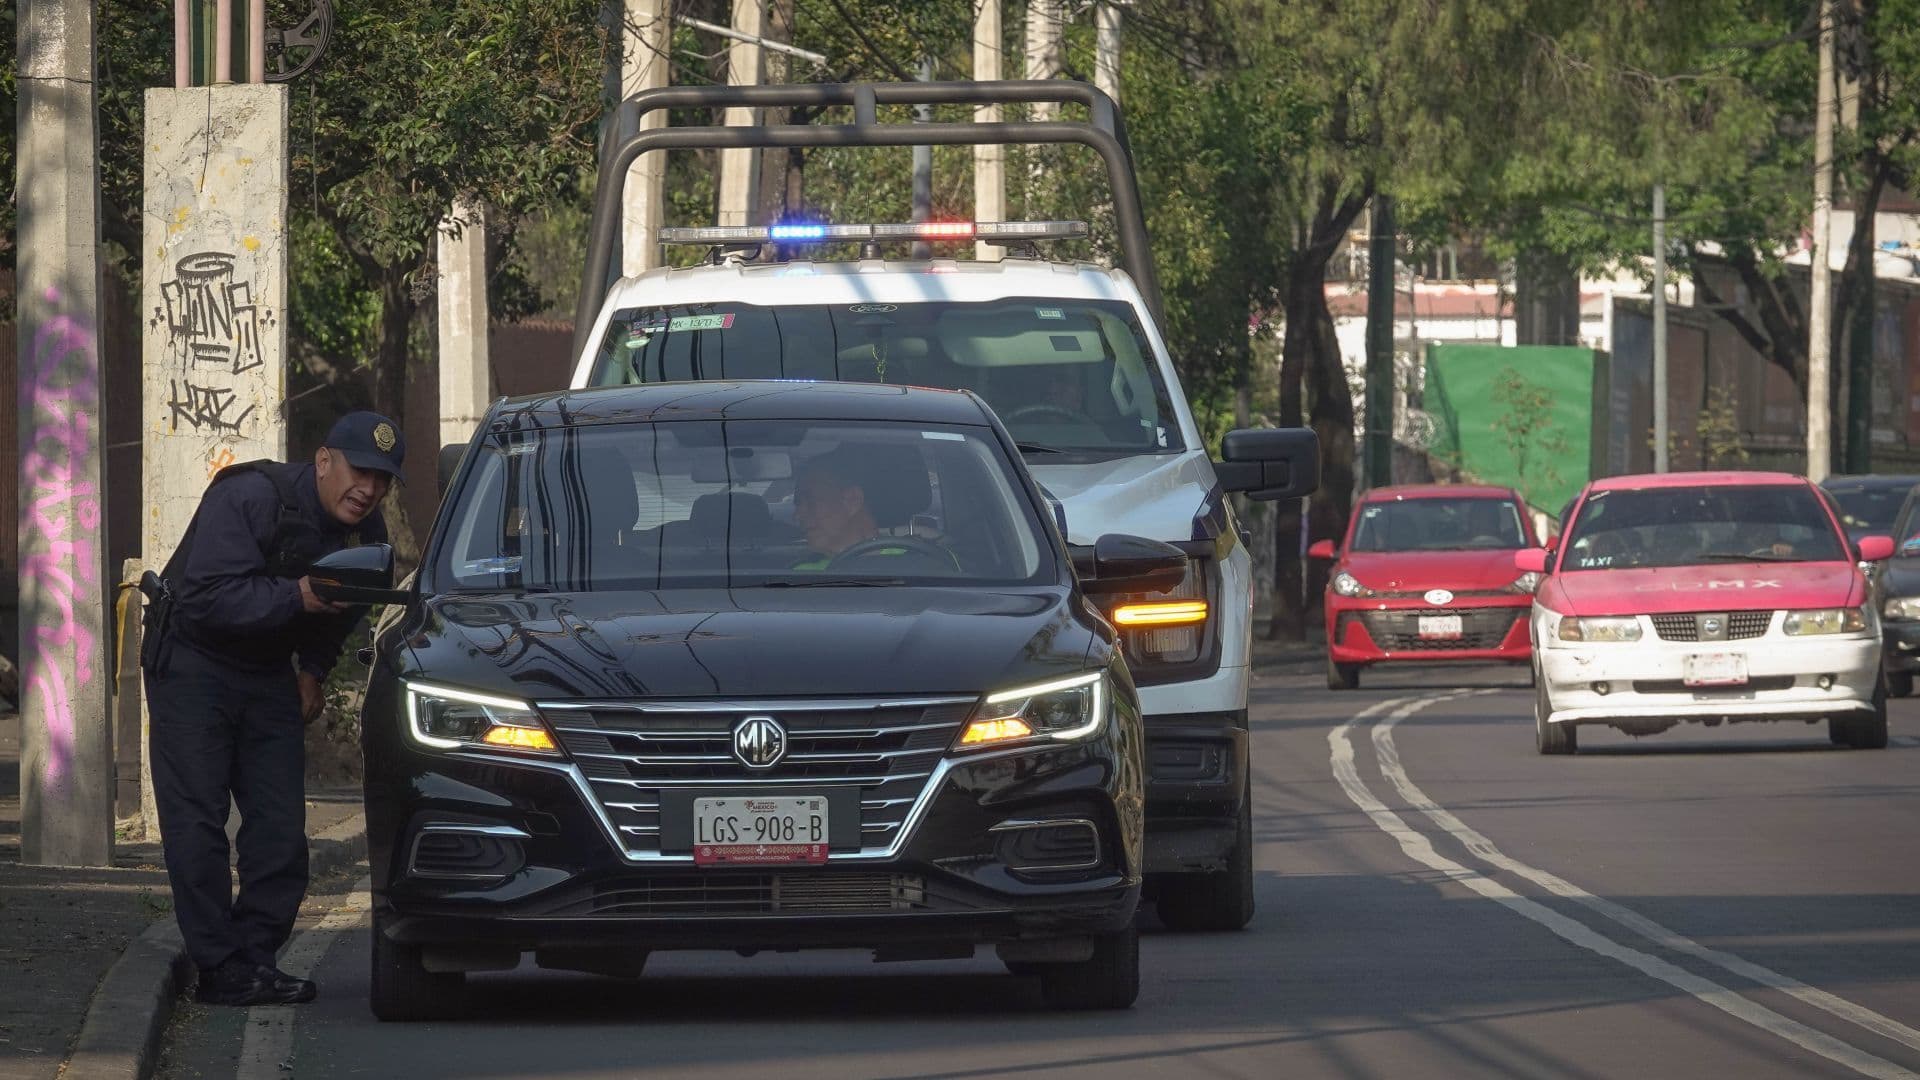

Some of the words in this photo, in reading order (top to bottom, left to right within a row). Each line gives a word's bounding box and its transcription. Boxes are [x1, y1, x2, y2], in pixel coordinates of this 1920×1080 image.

[1581, 556, 1613, 567] TAXI
[740, 721, 780, 762] MG
[699, 815, 822, 843] LGS-908-B
